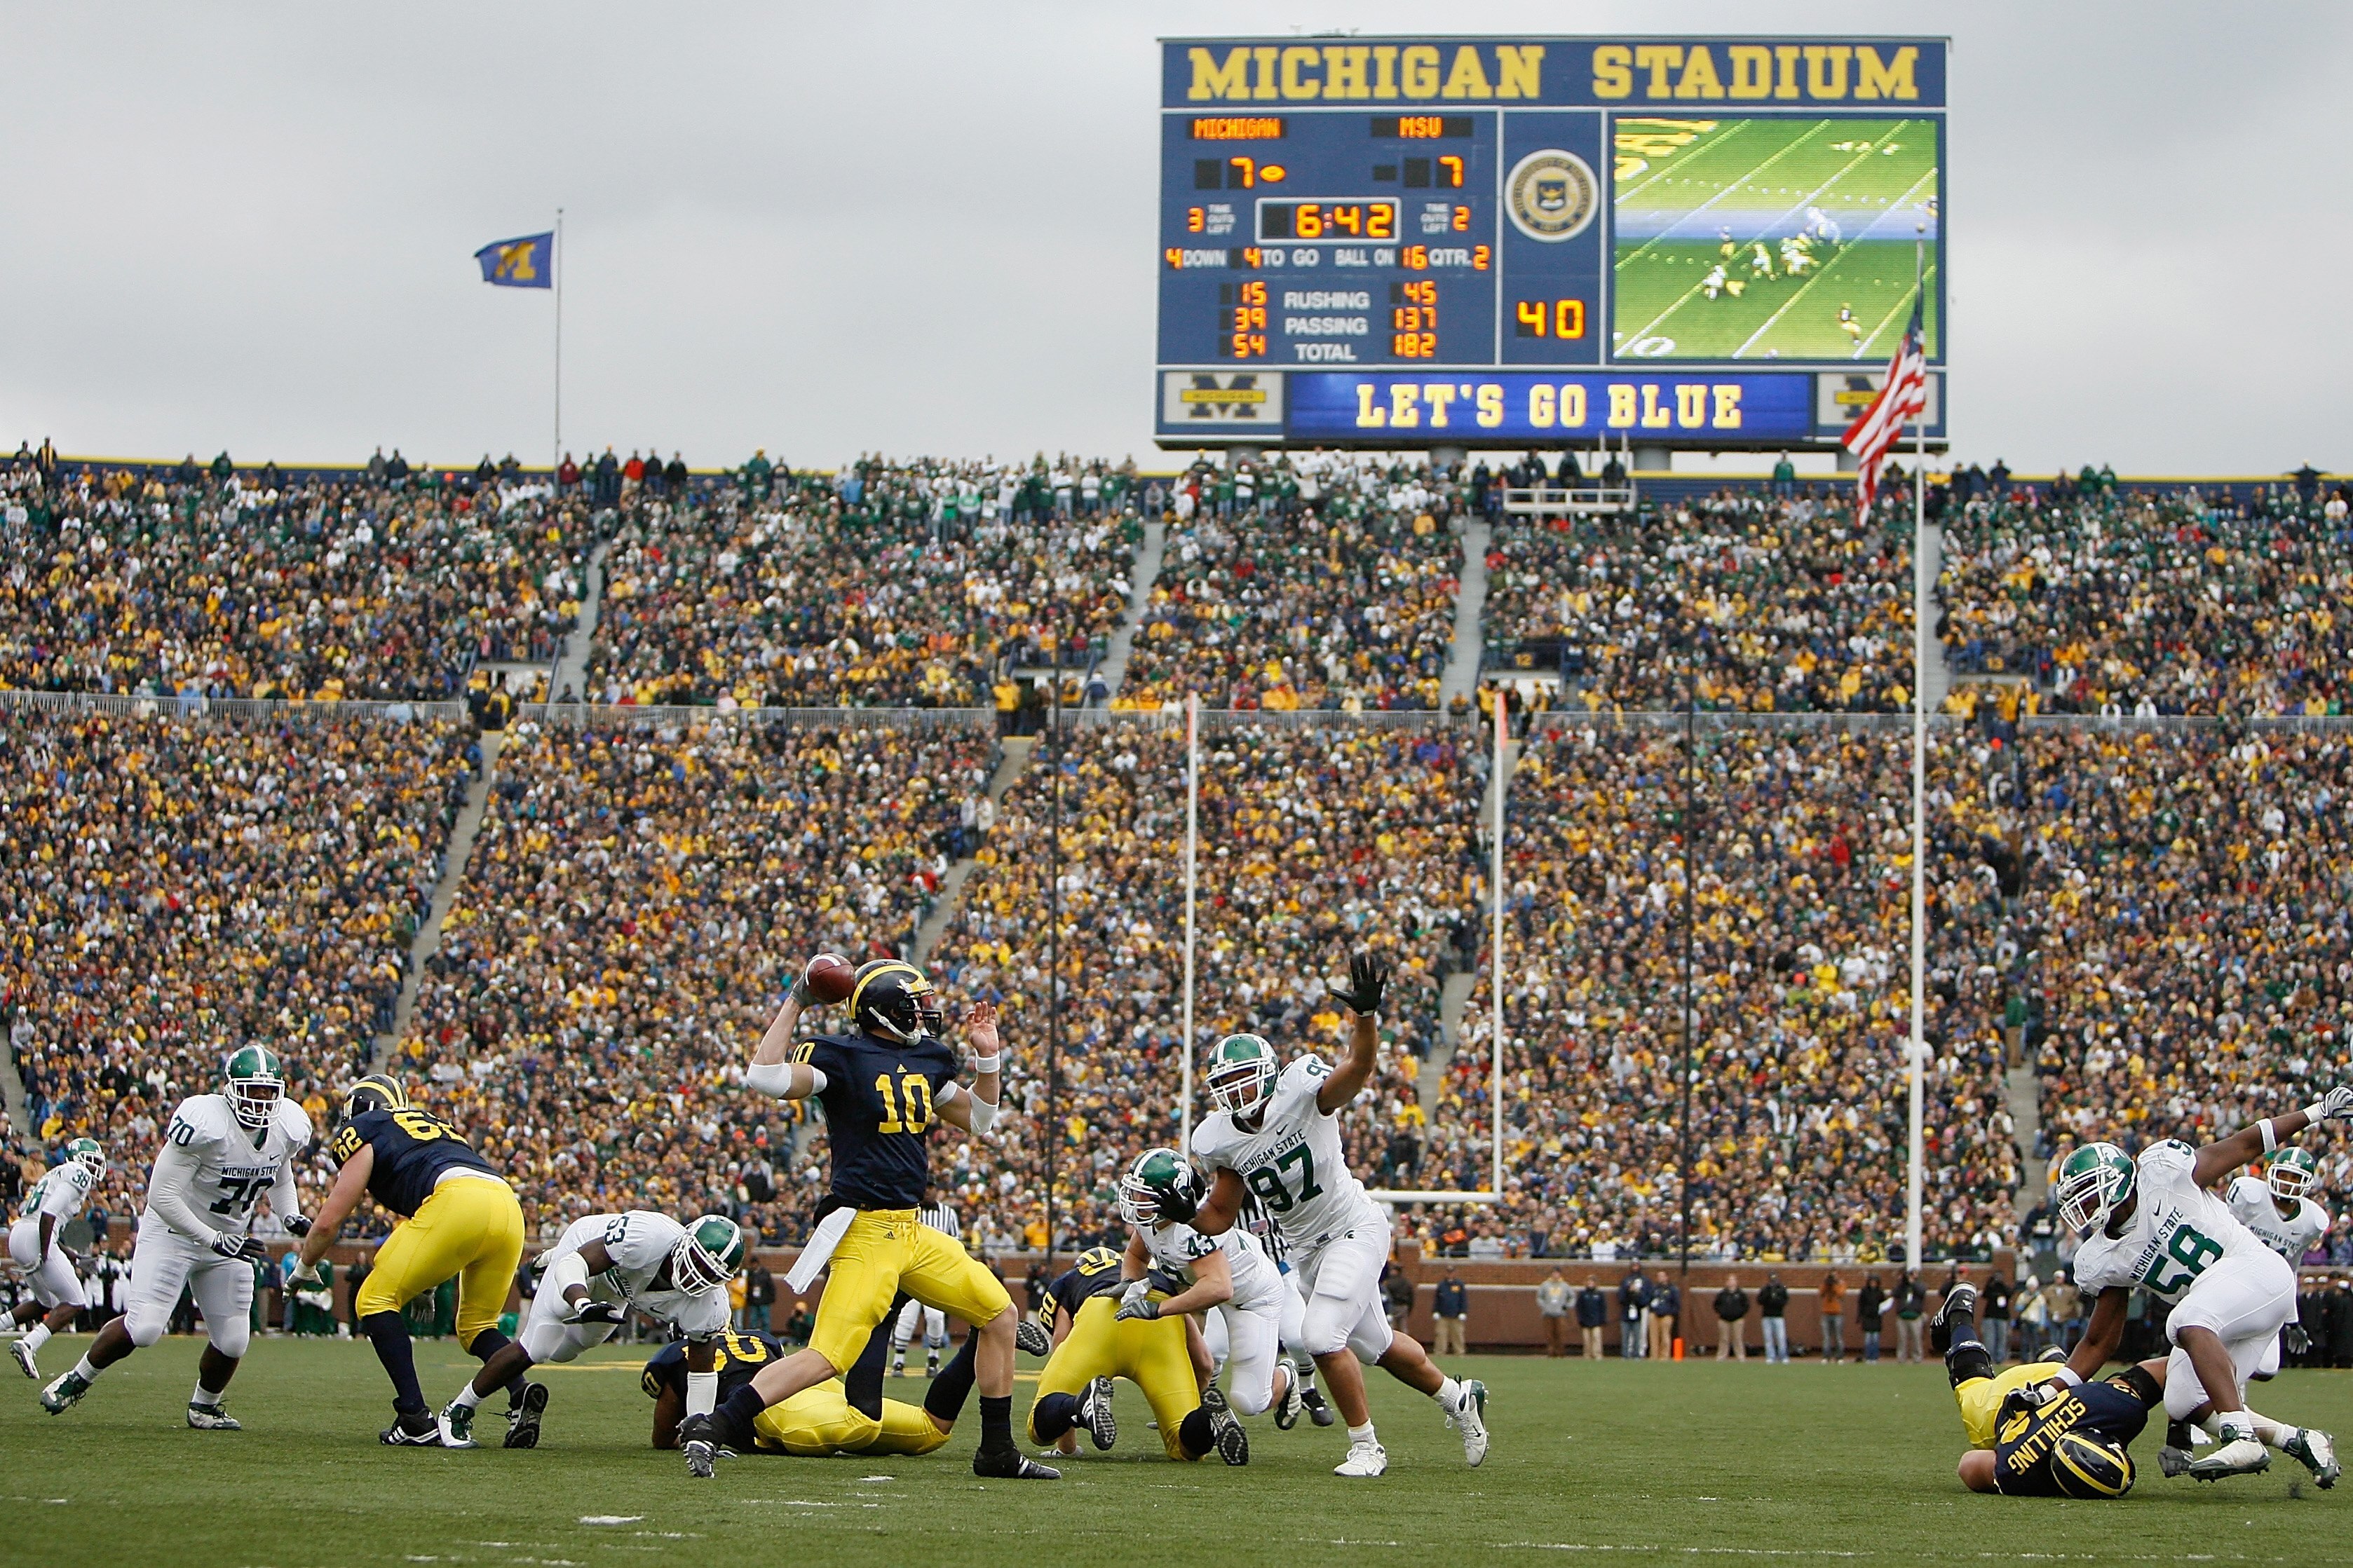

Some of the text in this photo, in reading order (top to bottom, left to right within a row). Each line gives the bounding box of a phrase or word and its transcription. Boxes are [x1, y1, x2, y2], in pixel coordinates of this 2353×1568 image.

[1188, 45, 1920, 100] MICHIGAN STADIUM
[1194, 118, 1281, 139] MICHIGAN
[1399, 117, 1442, 138] MSU
[1230, 157, 1254, 189] 7
[1438, 156, 1463, 188] 7
[1188, 206, 1205, 233] 3
[1296, 203, 1393, 238] 6:42
[1453, 205, 1470, 231] 2
[1165, 247, 1184, 269] 4
[1183, 249, 1227, 268] DOWN
[1243, 247, 1261, 269] 4
[1262, 248, 1286, 267] TO
[1292, 248, 1320, 267] GO
[1334, 248, 1369, 267] BALL
[1373, 248, 1396, 267] ON
[1402, 245, 1428, 270] 16
[1472, 245, 1491, 270] 2
[1242, 280, 1437, 310] 15 RUSHING 45
[1235, 307, 1437, 335] 39 PASSING 137
[1517, 299, 1585, 339] 40
[1233, 334, 1437, 362] 54 TOTAL 182
[1356, 383, 1742, 429] LET'S GO BLUE
[875, 1074, 933, 1134] 10
[168, 1114, 195, 1147] 70
[1276, 1129, 1306, 1153] STATE
[72, 1168, 90, 1189] 38
[222, 1166, 259, 1178] MICHIGAN
[1247, 1141, 1324, 1213] 97
[1188, 1232, 1217, 1257] 43
[2129, 1206, 2184, 1281] MICHIGAN STATE
[2142, 1224, 2225, 1295] 58
[2007, 1397, 2087, 1476] SCHILLING
